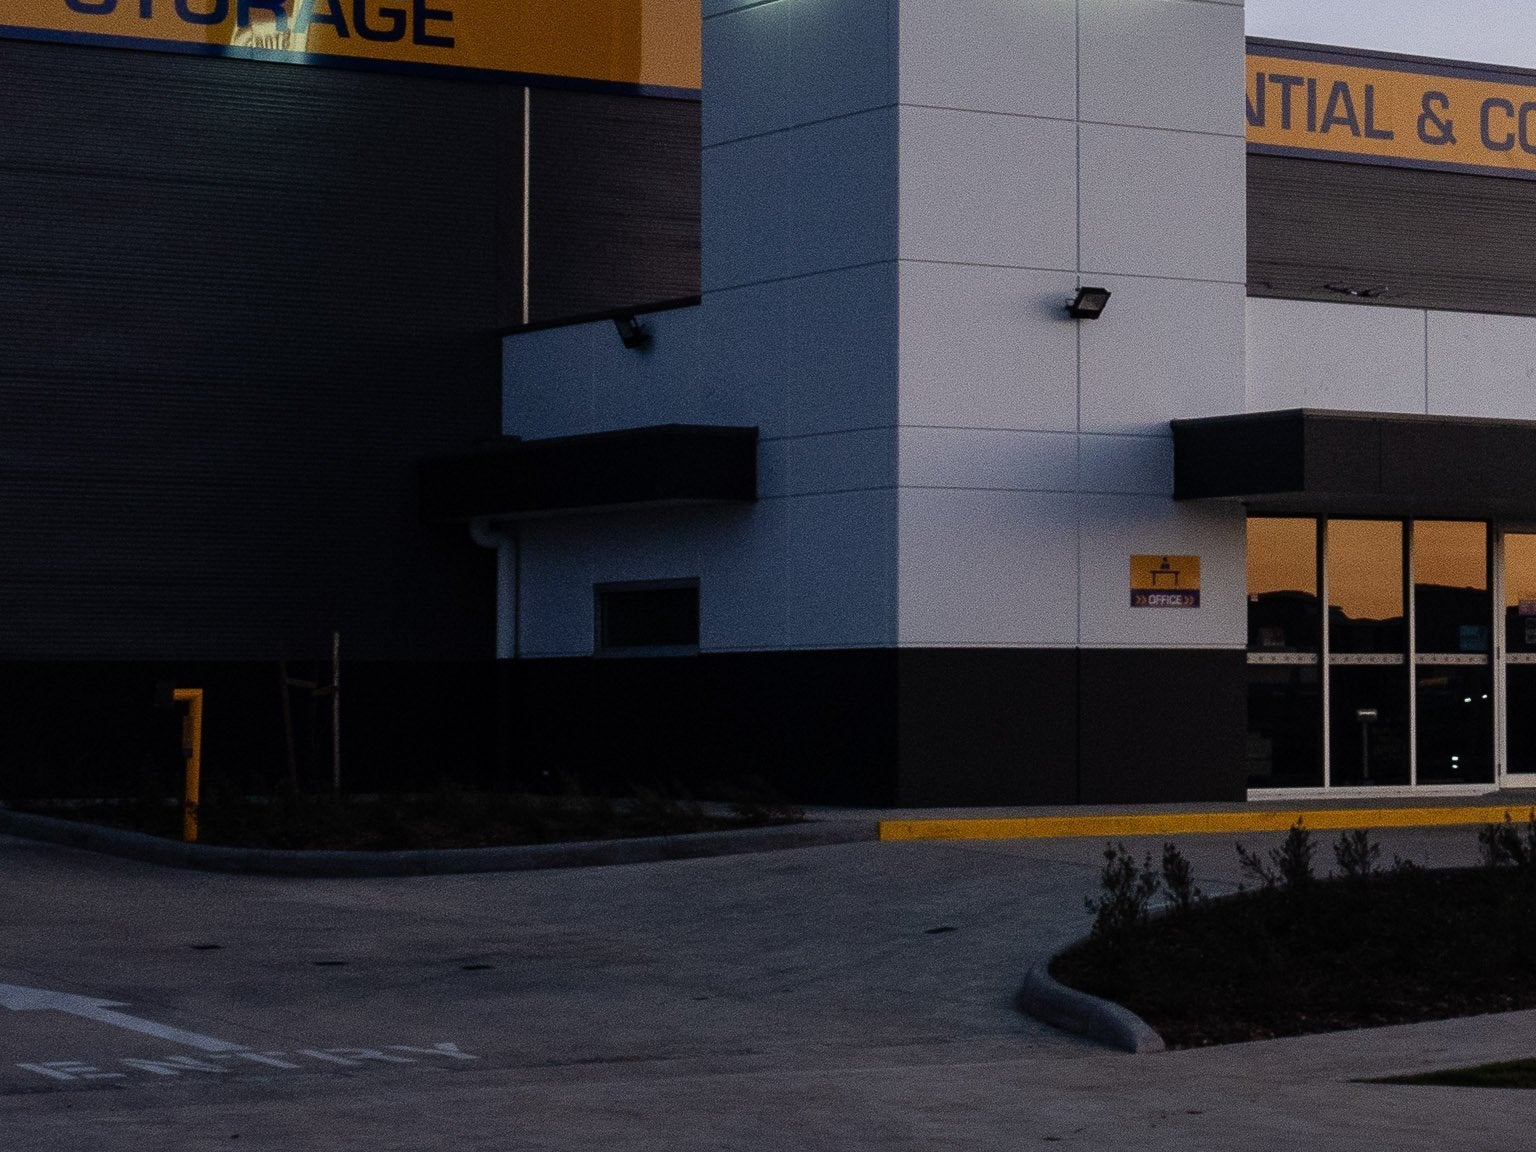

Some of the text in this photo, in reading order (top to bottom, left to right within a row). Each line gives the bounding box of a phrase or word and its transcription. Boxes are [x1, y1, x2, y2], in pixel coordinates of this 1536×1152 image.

[1416, 90, 1457, 145] &
[1148, 594, 1182, 605] OFFICE
[15, 1042, 480, 1080] ENTRY
